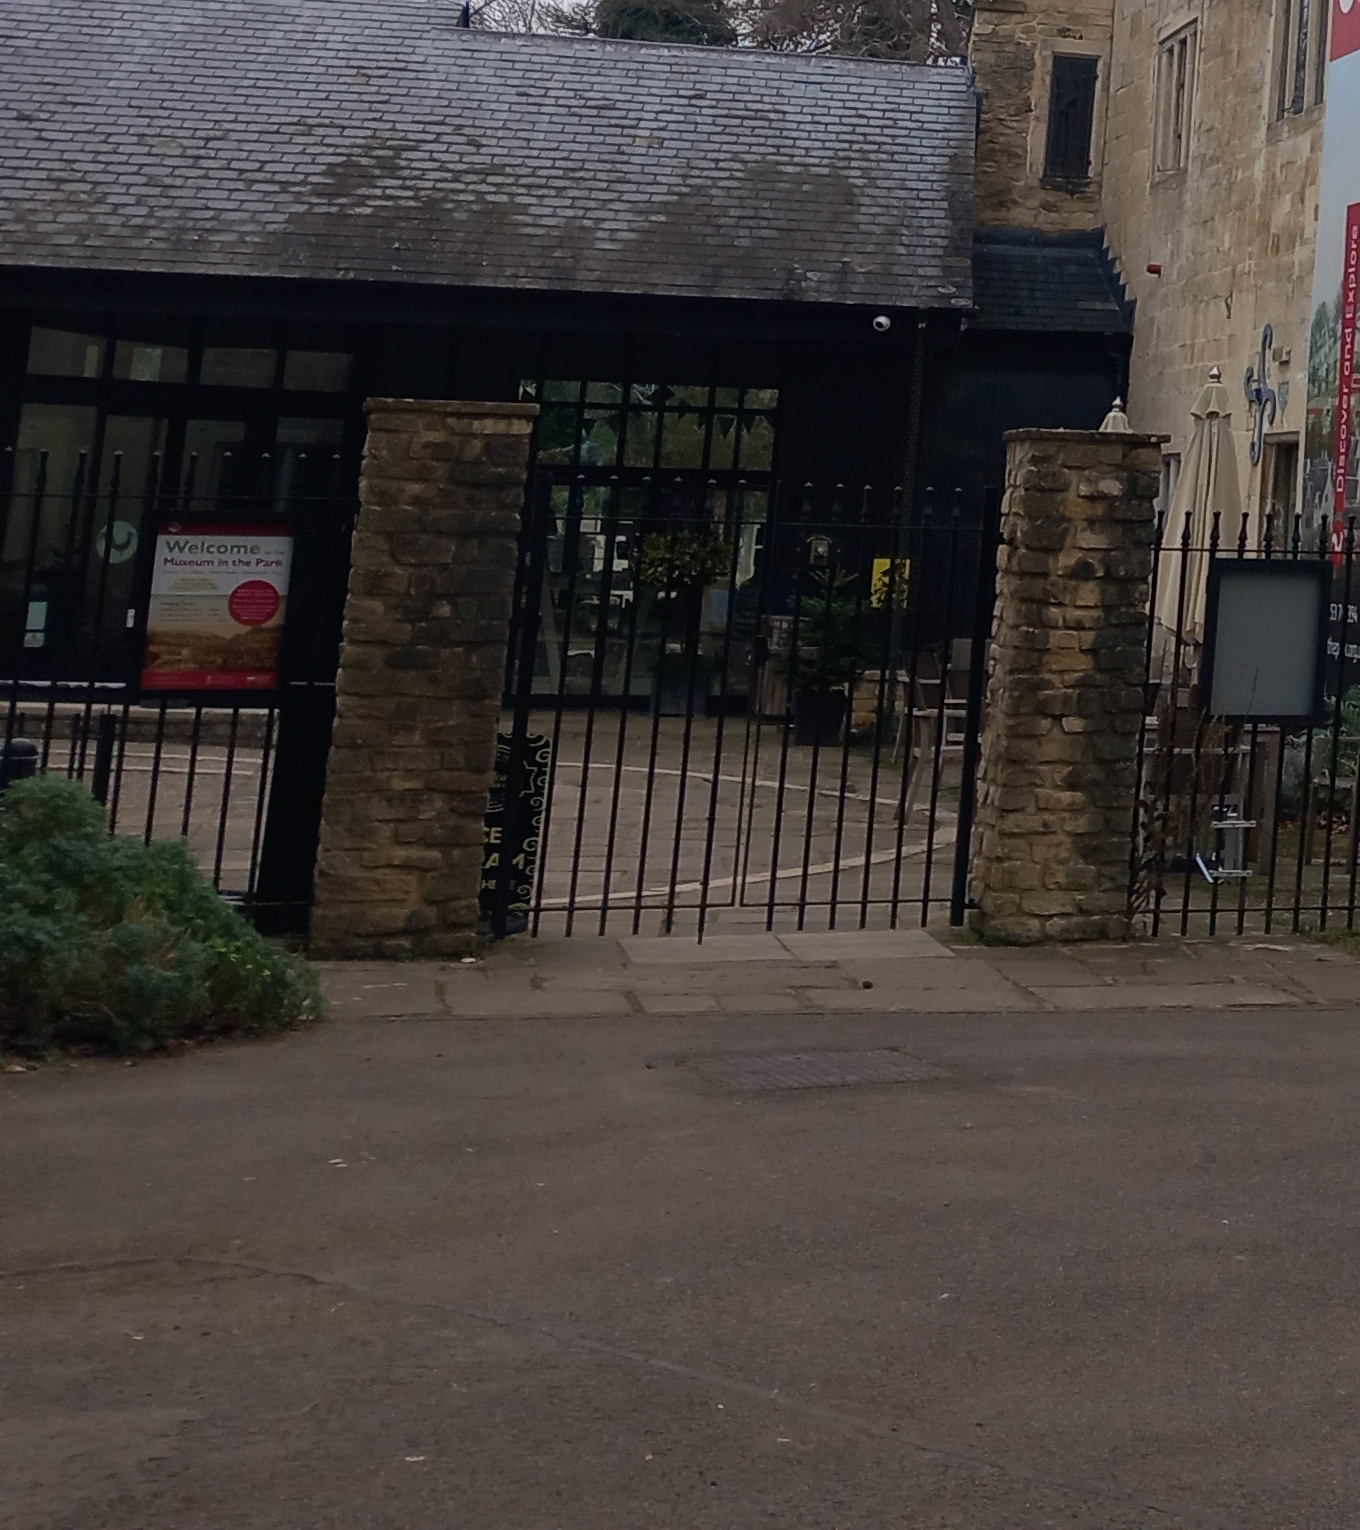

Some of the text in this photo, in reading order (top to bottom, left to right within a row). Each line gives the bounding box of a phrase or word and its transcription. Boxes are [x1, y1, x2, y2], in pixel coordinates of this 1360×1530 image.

[1336, 225, 1358, 493] Discover and Explore
[165, 540, 260, 555] Welcome
[163, 557, 283, 568] Museum in the Park
